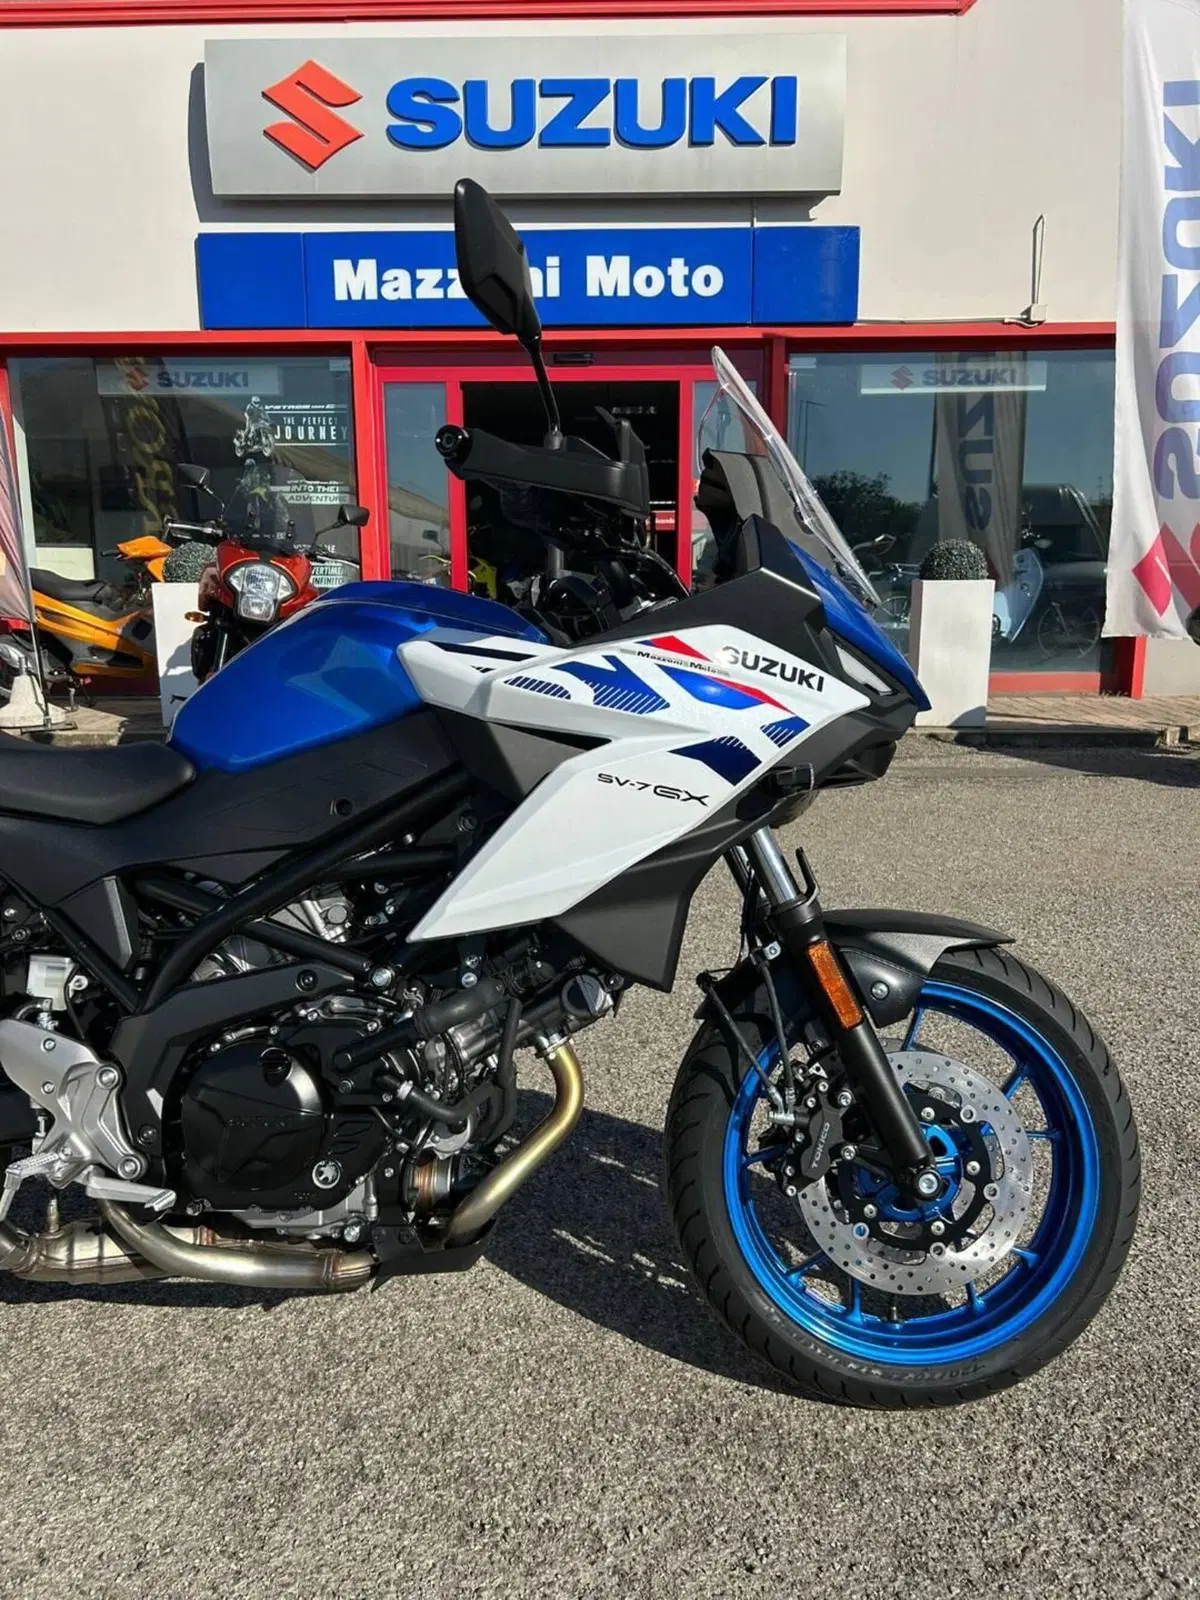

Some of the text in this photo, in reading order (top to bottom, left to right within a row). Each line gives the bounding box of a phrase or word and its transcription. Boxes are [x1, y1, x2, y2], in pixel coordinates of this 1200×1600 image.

[386, 75, 797, 149] SUZUKI
[333, 255, 724, 300] Mazzi Moto
[157, 371, 249, 388] SUZUKI
[922, 368, 1017, 386] SUZUKI
[283, 417, 295, 425] THE
[274, 425, 348, 440] JOURNEY
[290, 485, 314, 493] INTO
[720, 645, 825, 693] SUZUKI
[811, 1122, 831, 1169] TOKICO
